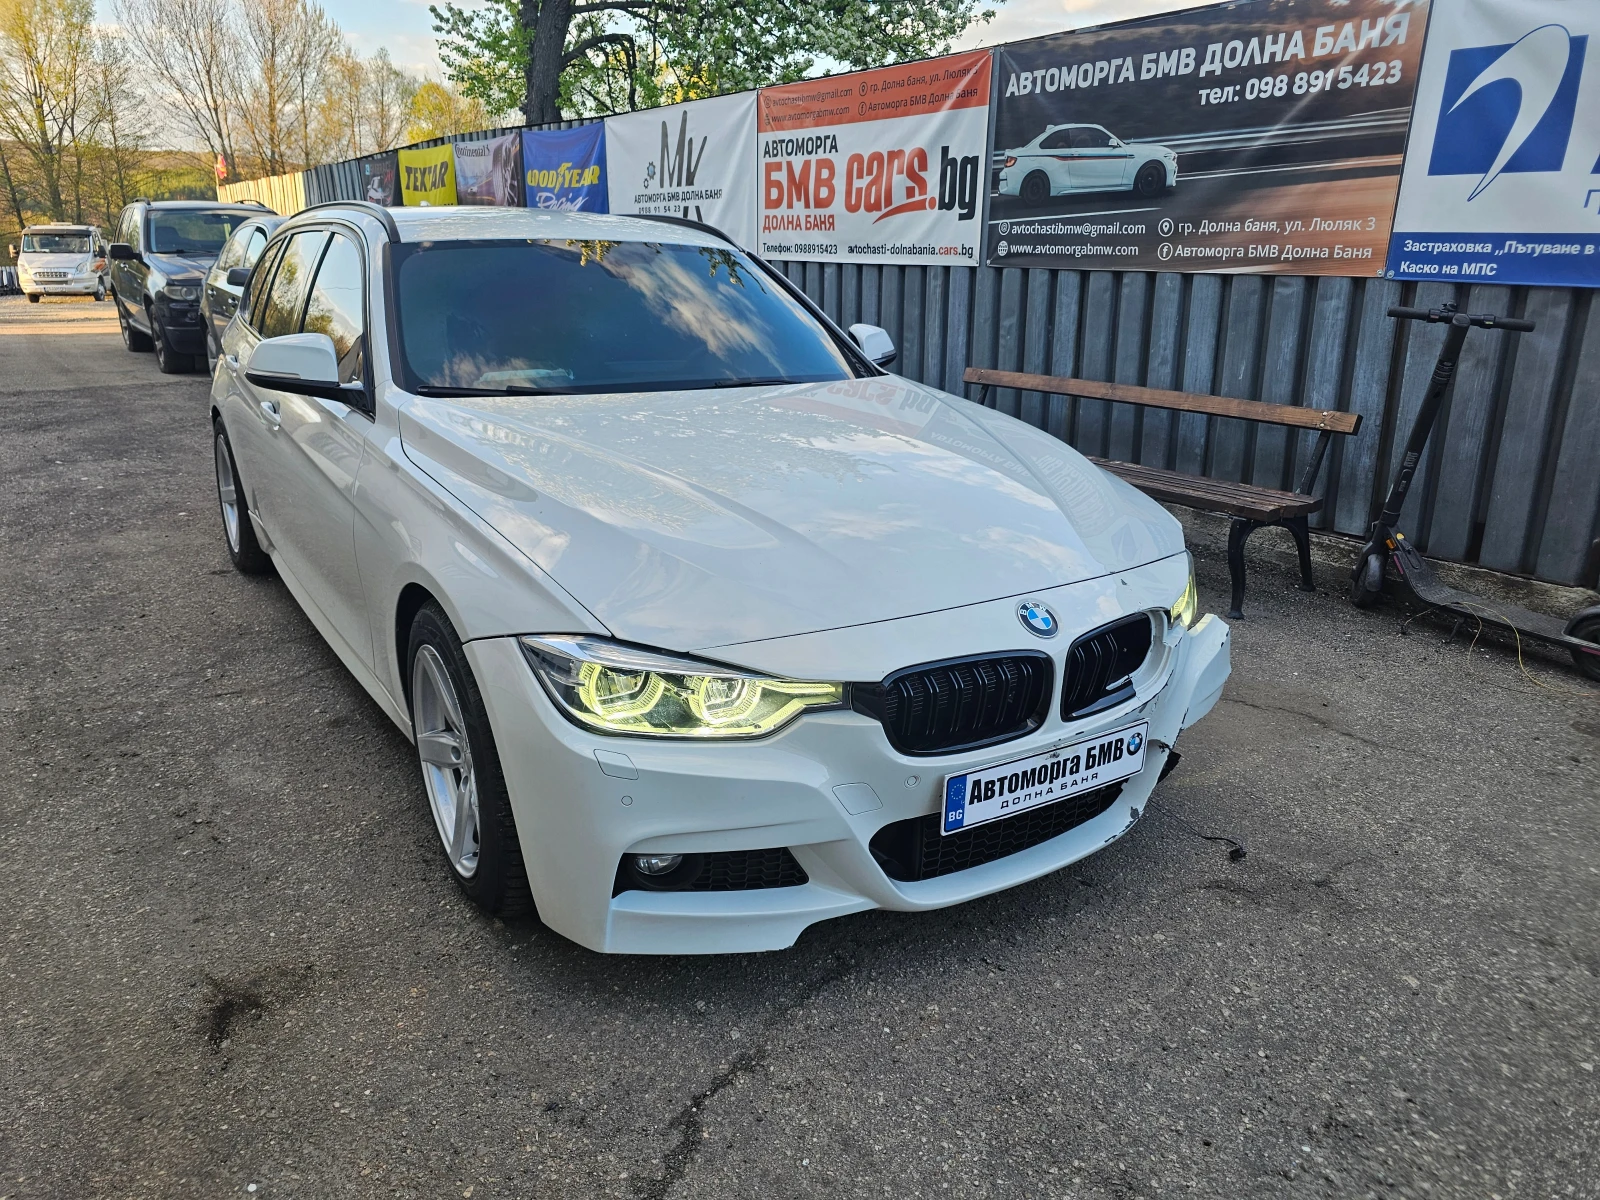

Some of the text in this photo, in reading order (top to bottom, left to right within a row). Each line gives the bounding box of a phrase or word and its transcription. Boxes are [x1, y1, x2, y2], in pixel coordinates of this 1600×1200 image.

[1005, 12, 1411, 98] АВТОМОРГА БМВ ДОЛНА БАНЯ
[1199, 60, 1402, 106] тел: 098 891 5423
[763, 134, 839, 158] АВТОМОРГА
[405, 161, 449, 192] TEXTAR
[764, 158, 836, 210] БМВ
[634, 193, 666, 204] АВТОМОРГА
[667, 191, 680, 202] БМВ
[681, 189, 704, 202] ДОЛНА
[762, 214, 835, 233] ДОЛНА БАНЯ
[1011, 222, 1146, 237] avtochastibmw@gmail.com
[1178, 217, 1376, 235] гр. Долна баня, ул. Люляк 3
[762, 243, 838, 255] Телефон: 0988915423
[1010, 243, 1139, 257] www.avtomorgabmw.com
[1175, 245, 1373, 261] Автоморга БМВ Долна Баня
[1404, 239, 1492, 254] Застраховка
[1584, 245, 1595, 254] в
[1400, 262, 1497, 275] Каско на МПС
[968, 738, 1124, 805] Автоморга БМВ
[1000, 772, 1098, 810] ДОЛНА БАНЯ
[948, 809, 963, 822] BG
